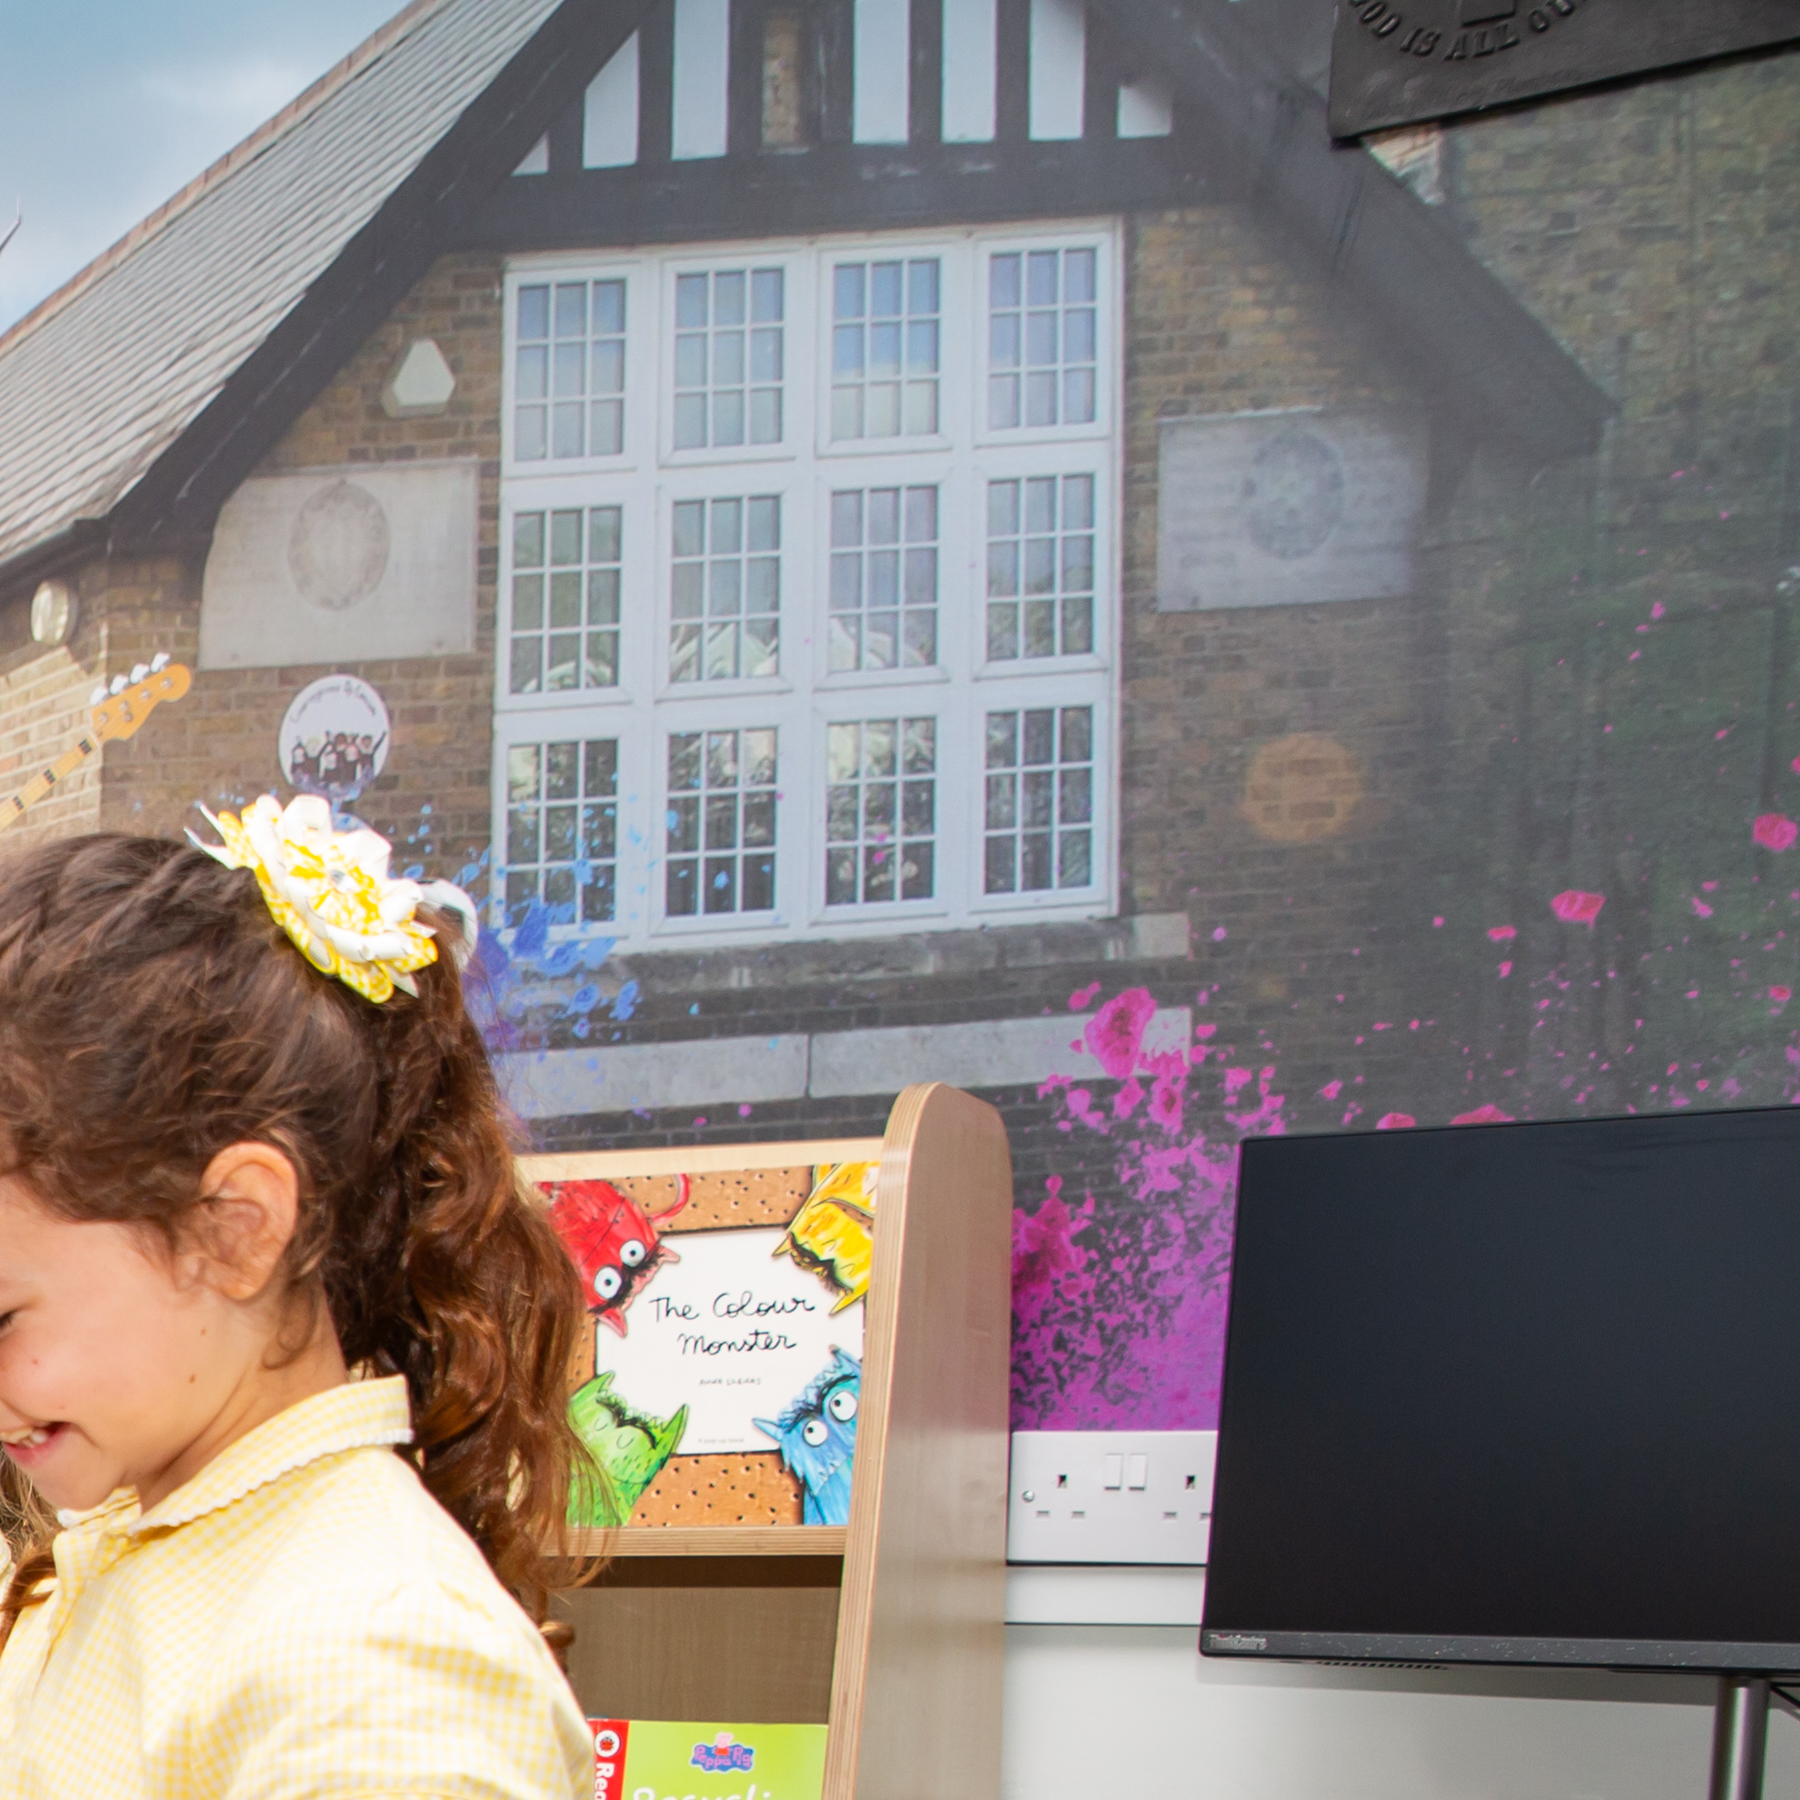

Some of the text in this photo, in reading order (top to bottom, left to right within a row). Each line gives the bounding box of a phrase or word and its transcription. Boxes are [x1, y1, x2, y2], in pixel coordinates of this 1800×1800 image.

[1400, 26, 1442, 57] IS
[1443, 23, 1521, 61] ALL
[649, 1290, 816, 1323] The Colour
[676, 1328, 798, 1356] Monster
[694, 1745, 752, 1769] Peppa Pig
